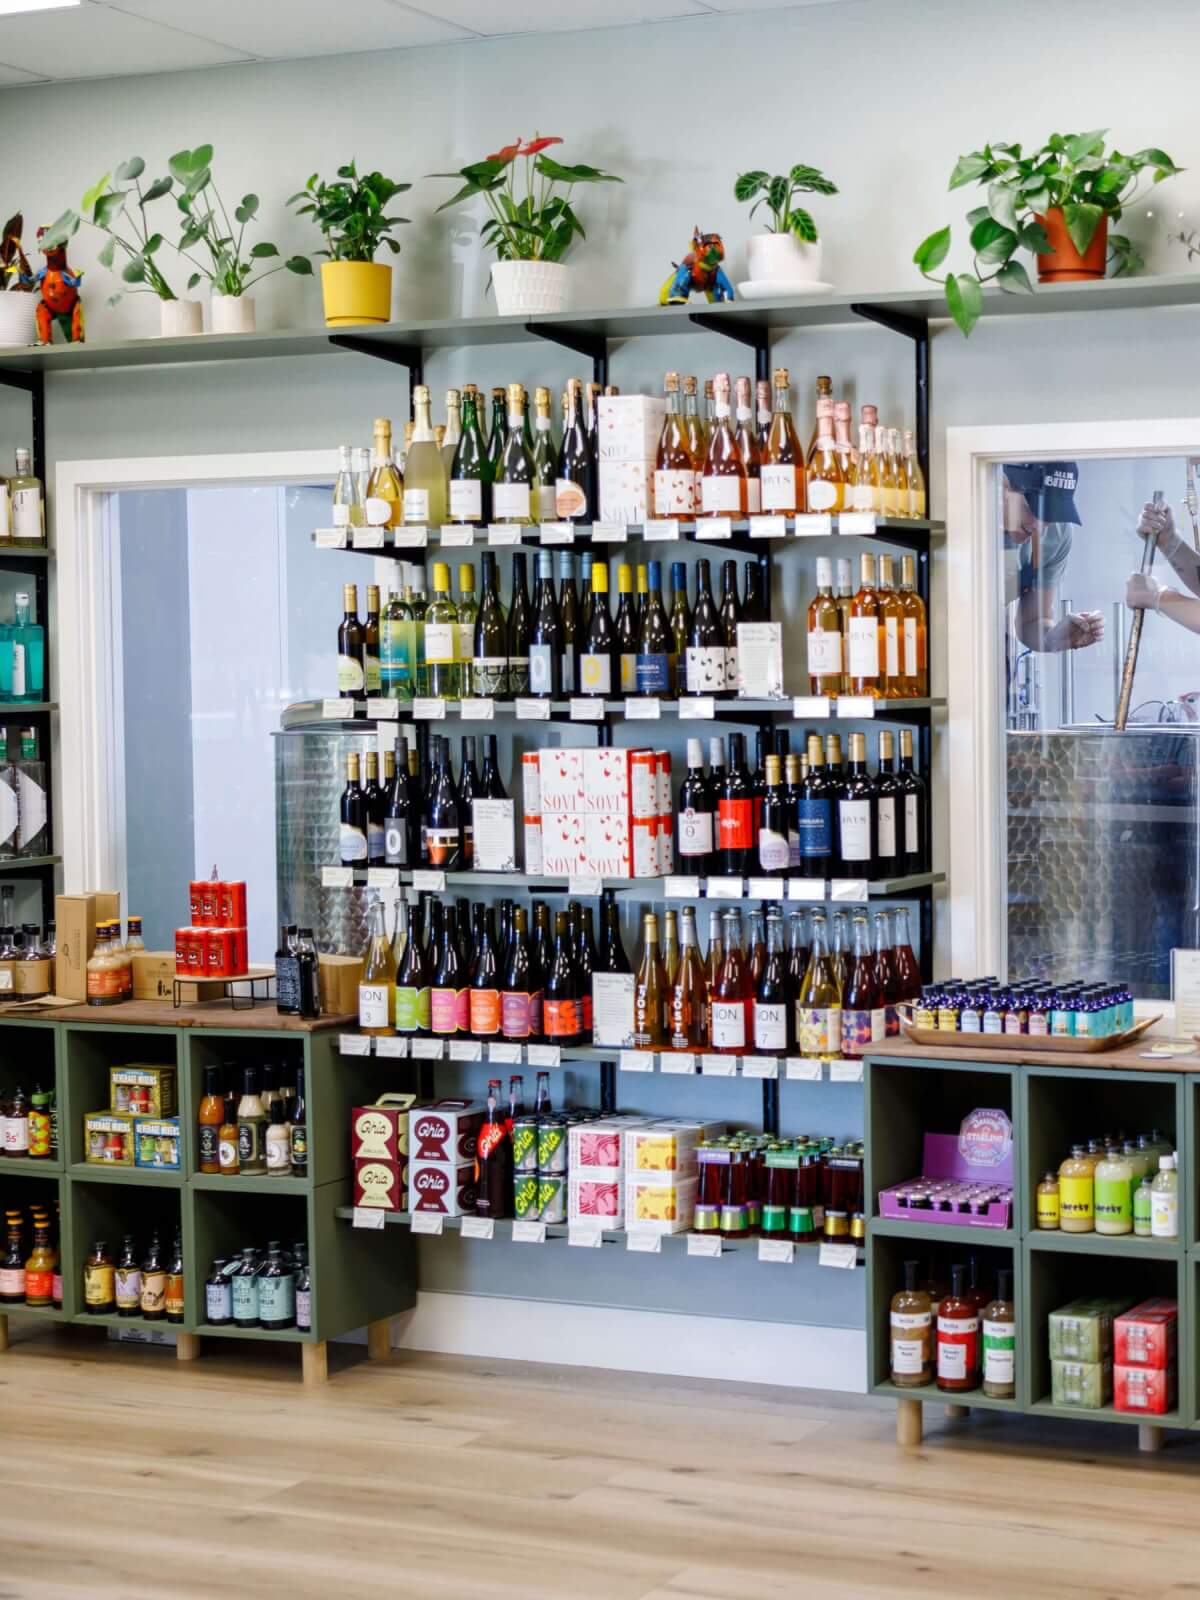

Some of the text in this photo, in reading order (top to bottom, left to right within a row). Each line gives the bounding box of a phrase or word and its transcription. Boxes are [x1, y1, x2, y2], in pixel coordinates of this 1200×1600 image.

[365, 1011, 372, 1023] 3
[760, 1033, 768, 1044] 7
[361, 1120, 387, 1135] Ghia
[418, 1122, 445, 1138] Ghia
[481, 1122, 502, 1153] Ghia
[513, 1130, 535, 1163] Ghia
[538, 1131, 561, 1165] Ghia
[363, 1170, 388, 1185] Ghia
[417, 1174, 445, 1190] Ghia
[515, 1180, 538, 1215] Ghia
